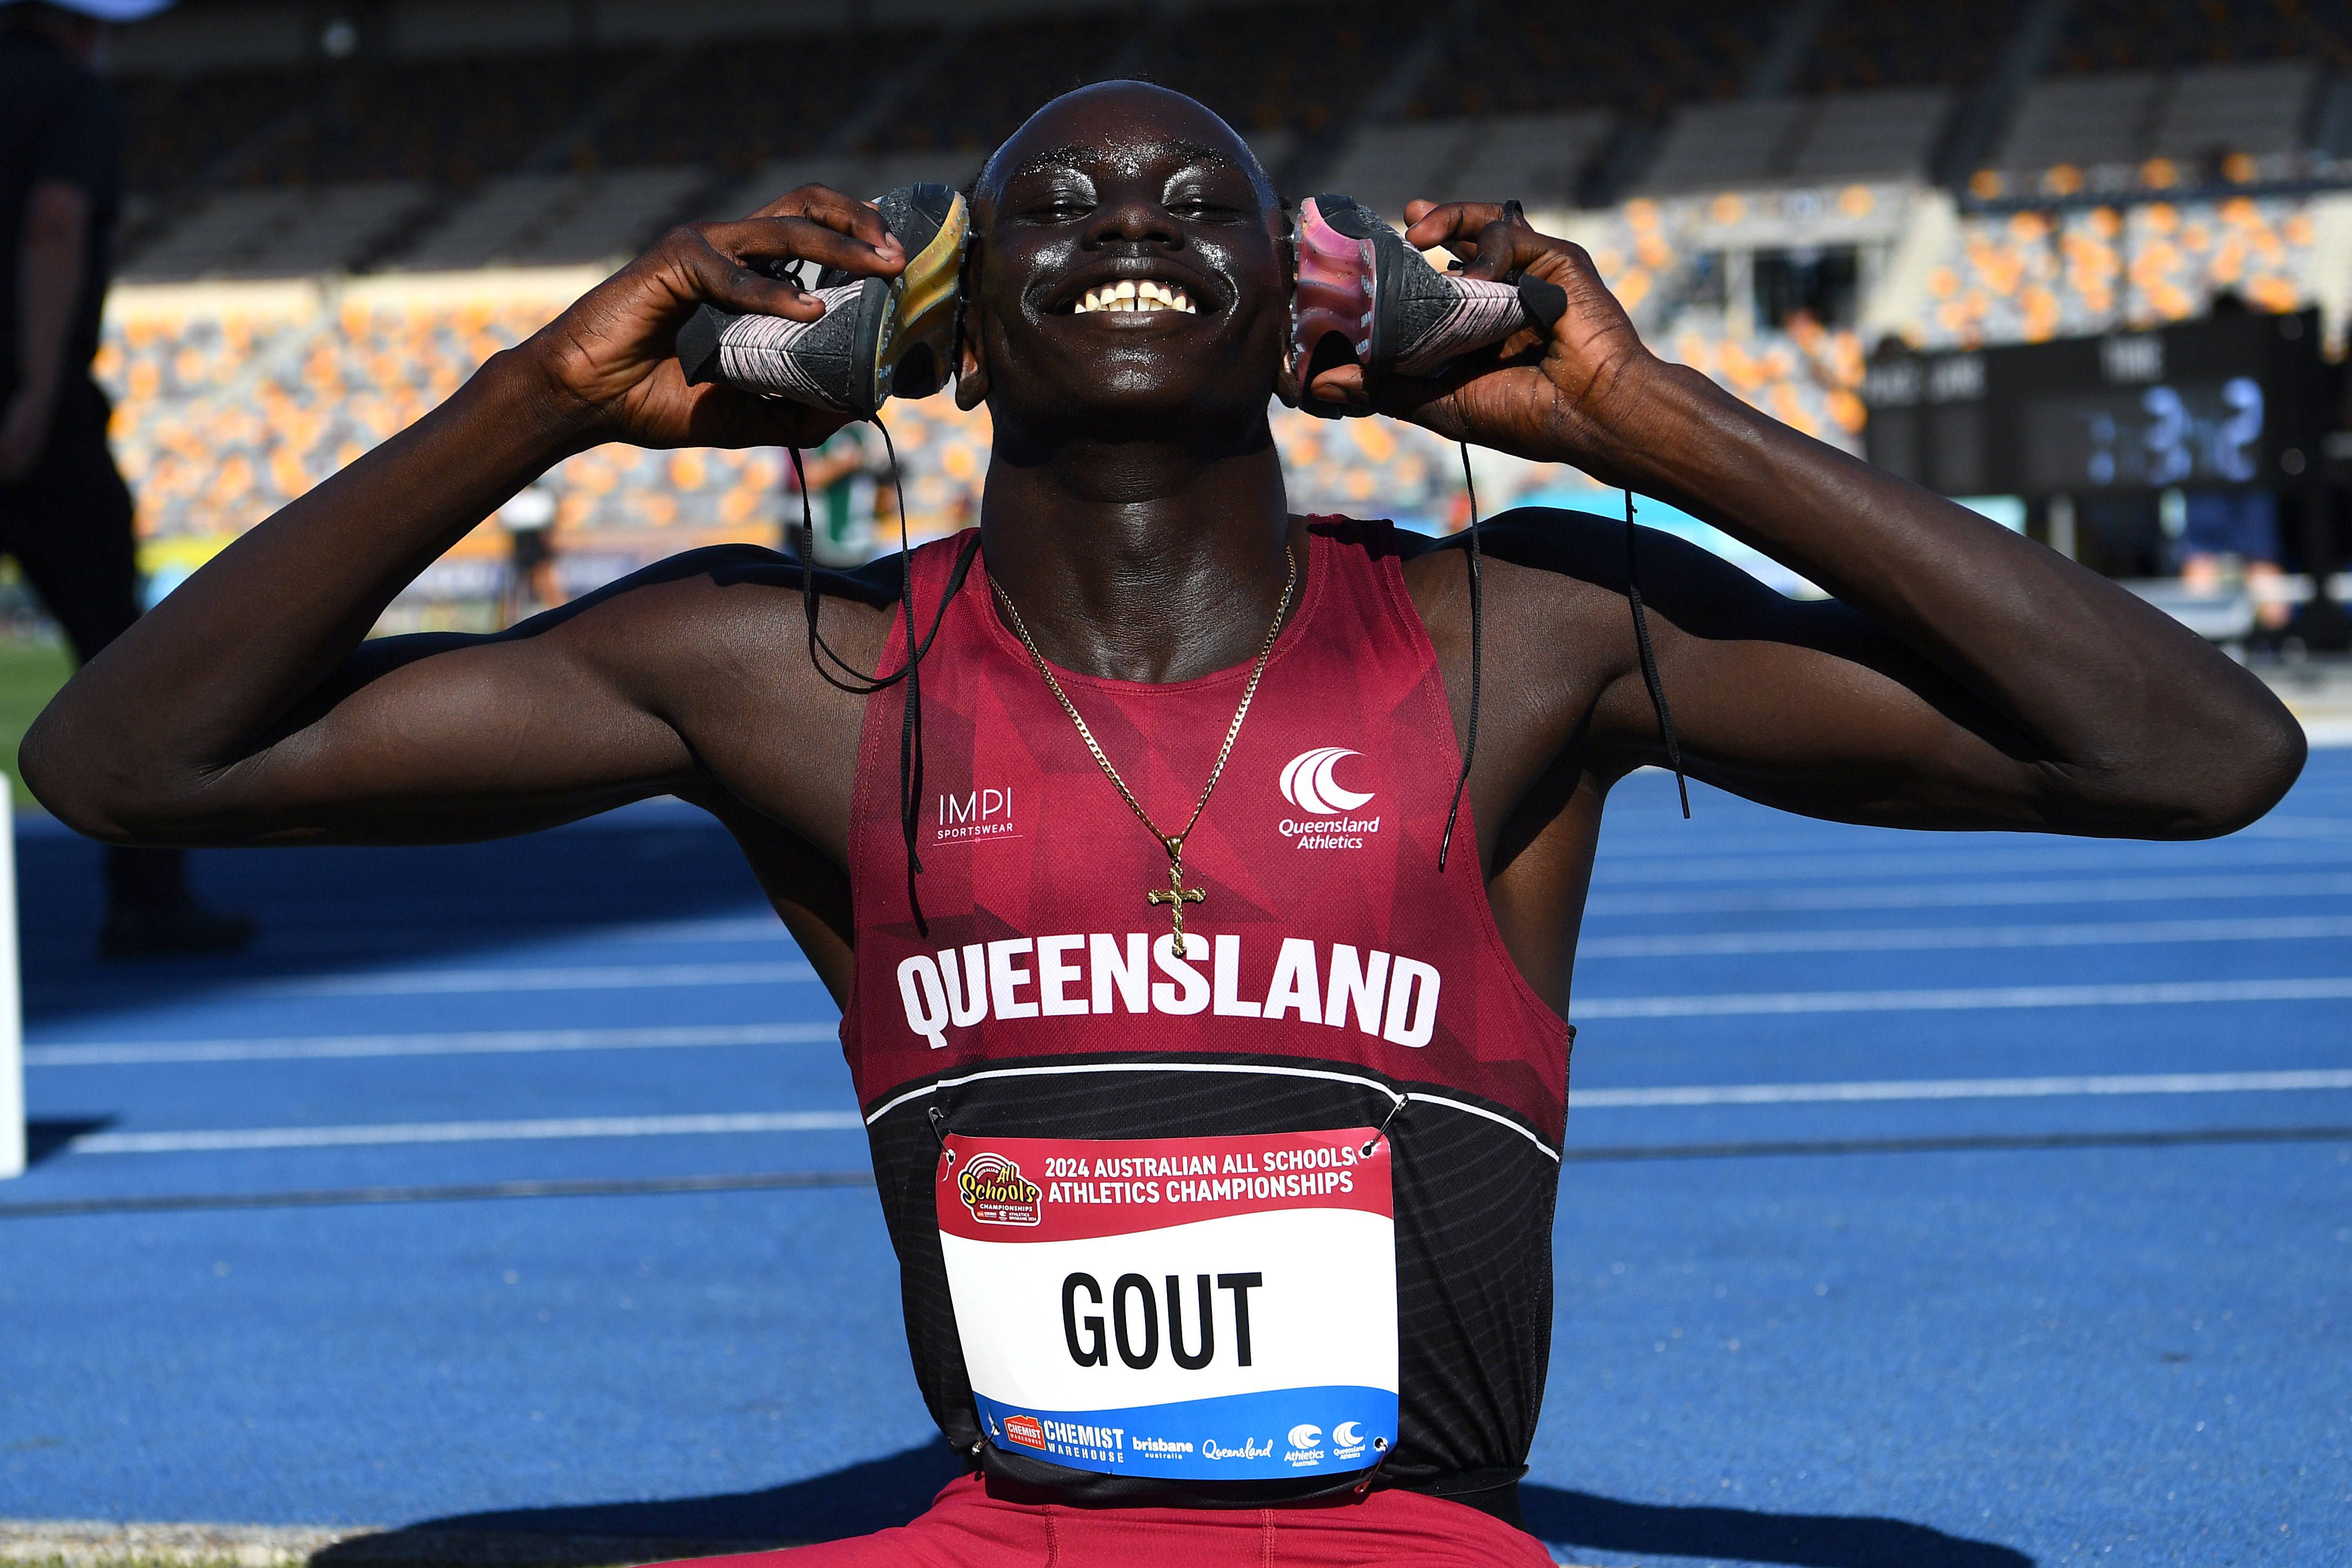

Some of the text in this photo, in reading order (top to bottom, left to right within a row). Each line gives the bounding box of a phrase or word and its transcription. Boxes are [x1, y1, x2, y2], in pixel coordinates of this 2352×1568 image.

[940, 787, 1011, 826] IMPI
[937, 823, 1013, 839] SPORTSWEAR
[1279, 816, 1380, 837] Queensland
[1297, 834, 1363, 849] Athletics
[897, 933, 1441, 1049] QUEENSLAND
[1045, 1146, 1354, 1177] 2024 AUSTRALIAN ALL SCHOOLS
[976, 1167, 999, 1179] AUSTRALIAN
[962, 1173, 1036, 1204] Schools
[1048, 1171, 1354, 1204] ATHLETICS CHAMPIONSHIPS
[1062, 1272, 1263, 1370] GOUT
[1007, 1423, 1041, 1439] CHEMIST
[1044, 1420, 1124, 1450] CHEMIST
[1047, 1442, 1124, 1463] WAREHOUSE
[1132, 1437, 1194, 1453] brisbane
[1202, 1437, 1274, 1459] Queensland
[1284, 1449, 1324, 1462] Athletics
[1334, 1444, 1365, 1456] Queensland
[1340, 1452, 1361, 1460] Athletics
